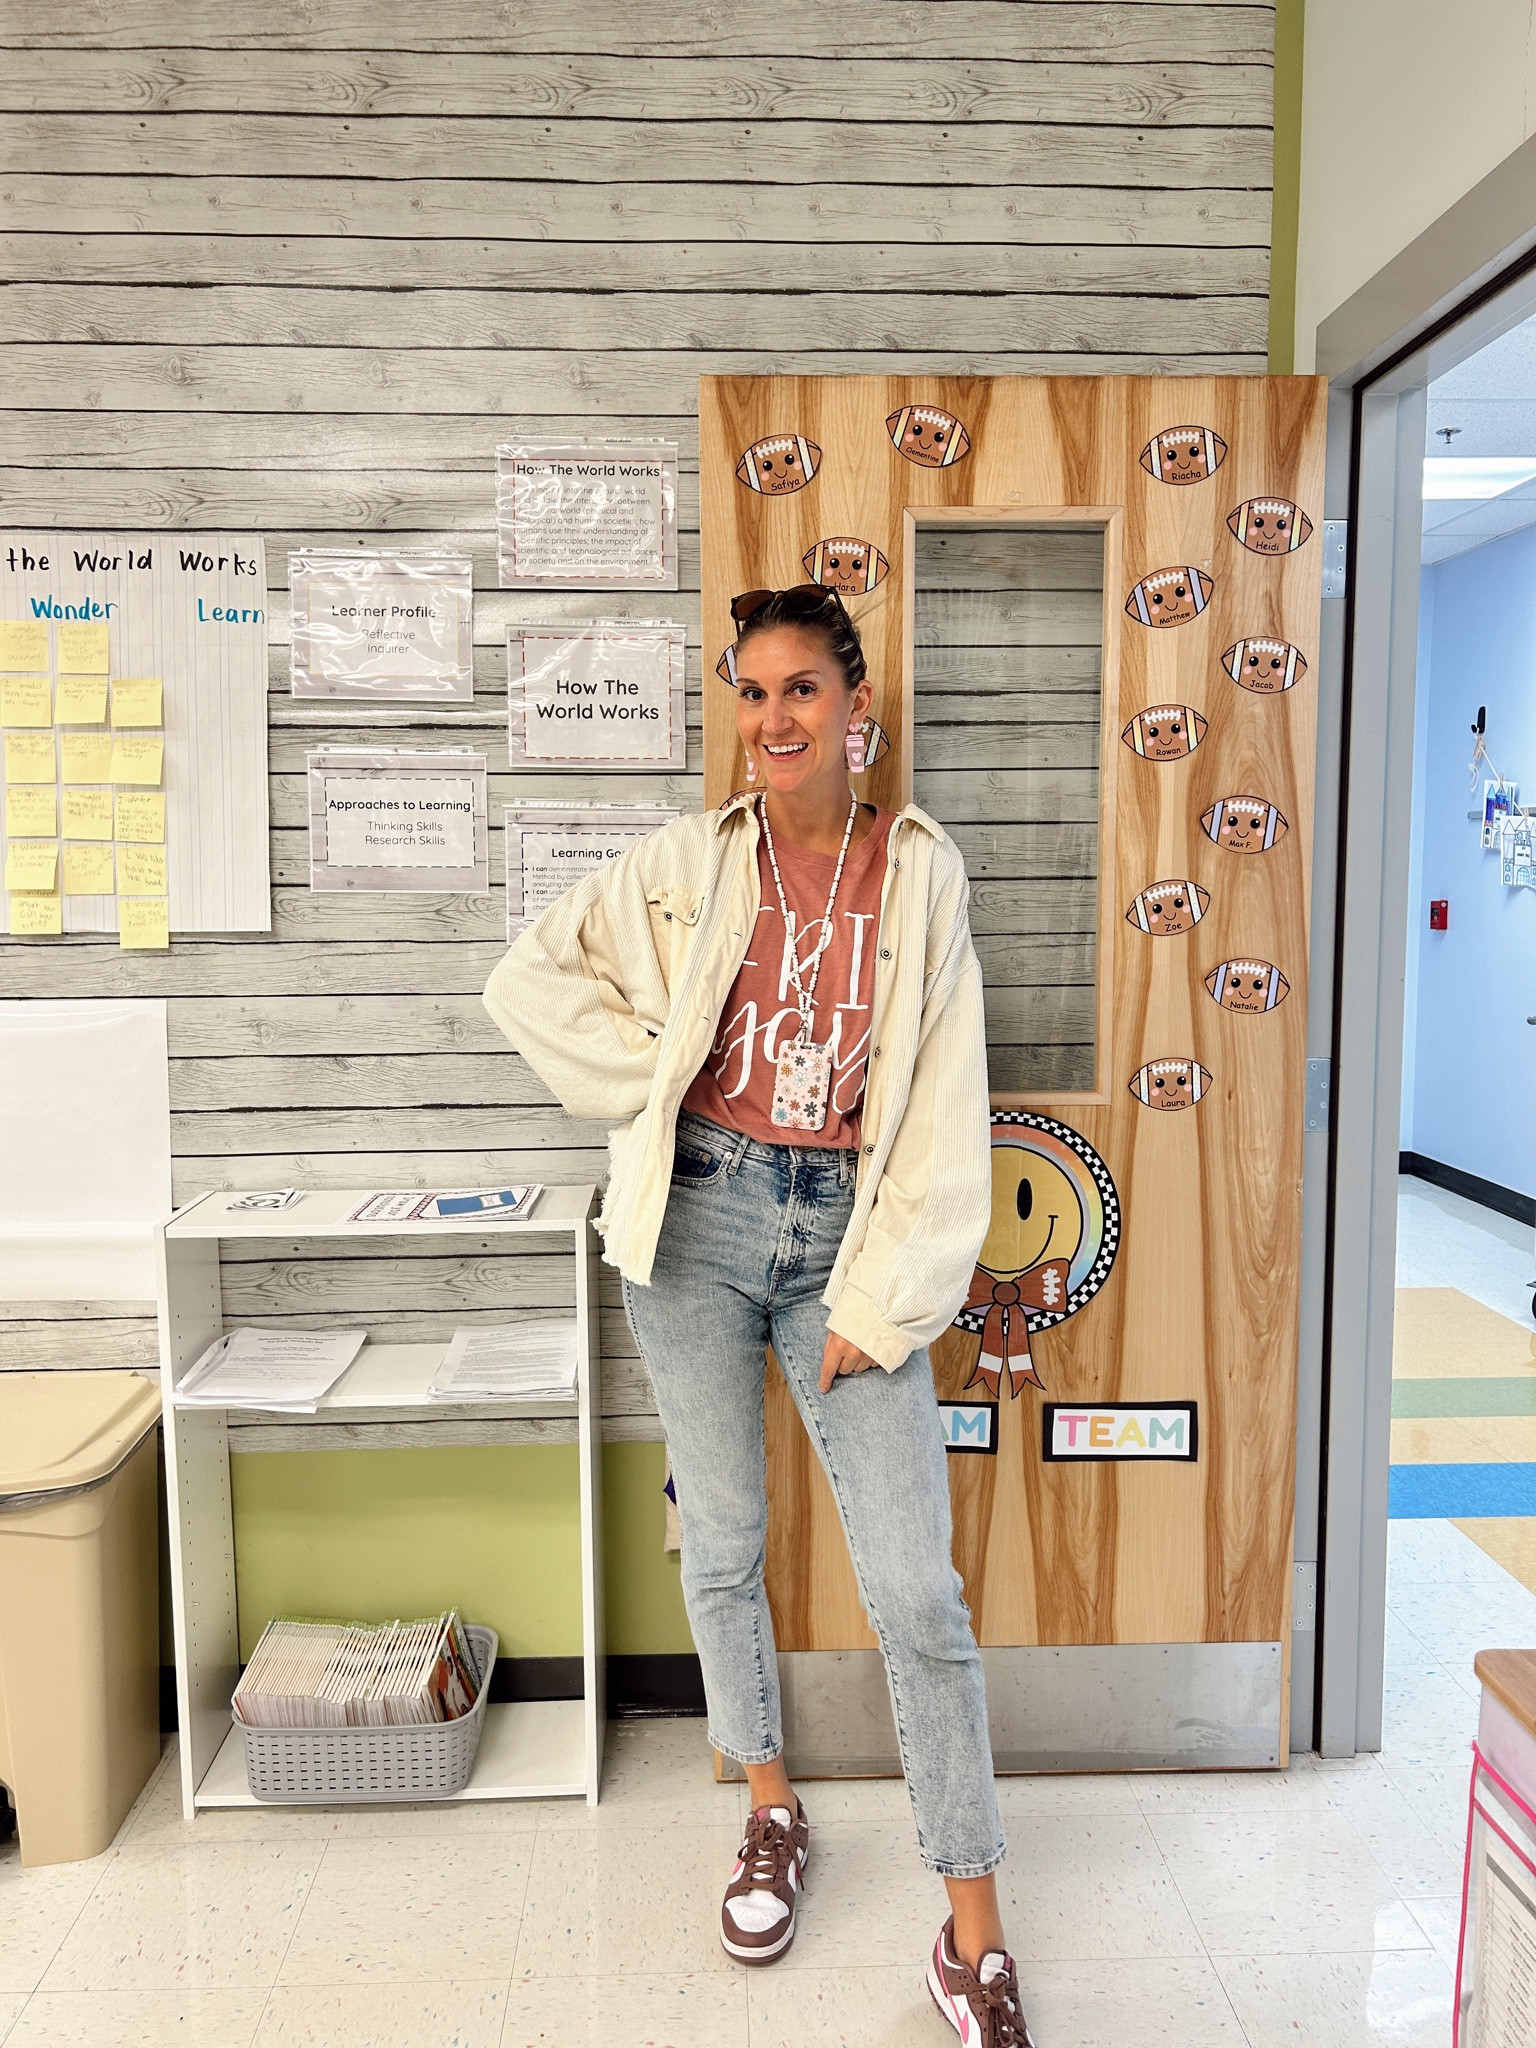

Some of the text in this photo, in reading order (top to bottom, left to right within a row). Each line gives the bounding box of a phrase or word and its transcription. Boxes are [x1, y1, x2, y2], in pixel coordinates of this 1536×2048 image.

[905, 446, 939, 463] Clementine
[550, 464, 573, 475] The
[577, 465, 615, 476] World
[619, 465, 660, 477] Works
[1171, 471, 1202, 482] Riacha
[770, 478, 801, 492] Safiya
[618, 507, 634, 515] and
[639, 517, 656, 525] how
[583, 527, 639, 537] understanding
[640, 528, 649, 536] of
[551, 538, 590, 547] principles,
[591, 537, 604, 545] the
[605, 538, 631, 547] impact
[1255, 541, 1280, 551] Heidi
[516, 547, 550, 555] scientific
[6, 547, 257, 576] the World Works
[528, 558, 556, 567] society
[586, 558, 599, 566] the
[30, 594, 266, 625] Wonder Learn
[332, 605, 436, 618] Learner Profile
[1158, 611, 1191, 626] Matthew
[362, 629, 416, 640] Reflective
[367, 643, 410, 655] Inquirer
[556, 679, 639, 695] How The
[1249, 679, 1274, 690] Jacob
[536, 703, 660, 719] World Works
[1156, 747, 1182, 757] Rowan
[329, 800, 471, 812] Approaches to Learning
[367, 821, 443, 833] Thinking Skills
[365, 834, 446, 846] Research Skills
[1228, 839, 1253, 849] Max F.
[552, 848, 603, 860] Learning
[1165, 922, 1183, 932] Zoe
[1229, 1001, 1259, 1011] Natalie
[1160, 1099, 1186, 1107] Laura
[1058, 1415, 1185, 1449] TEAM
